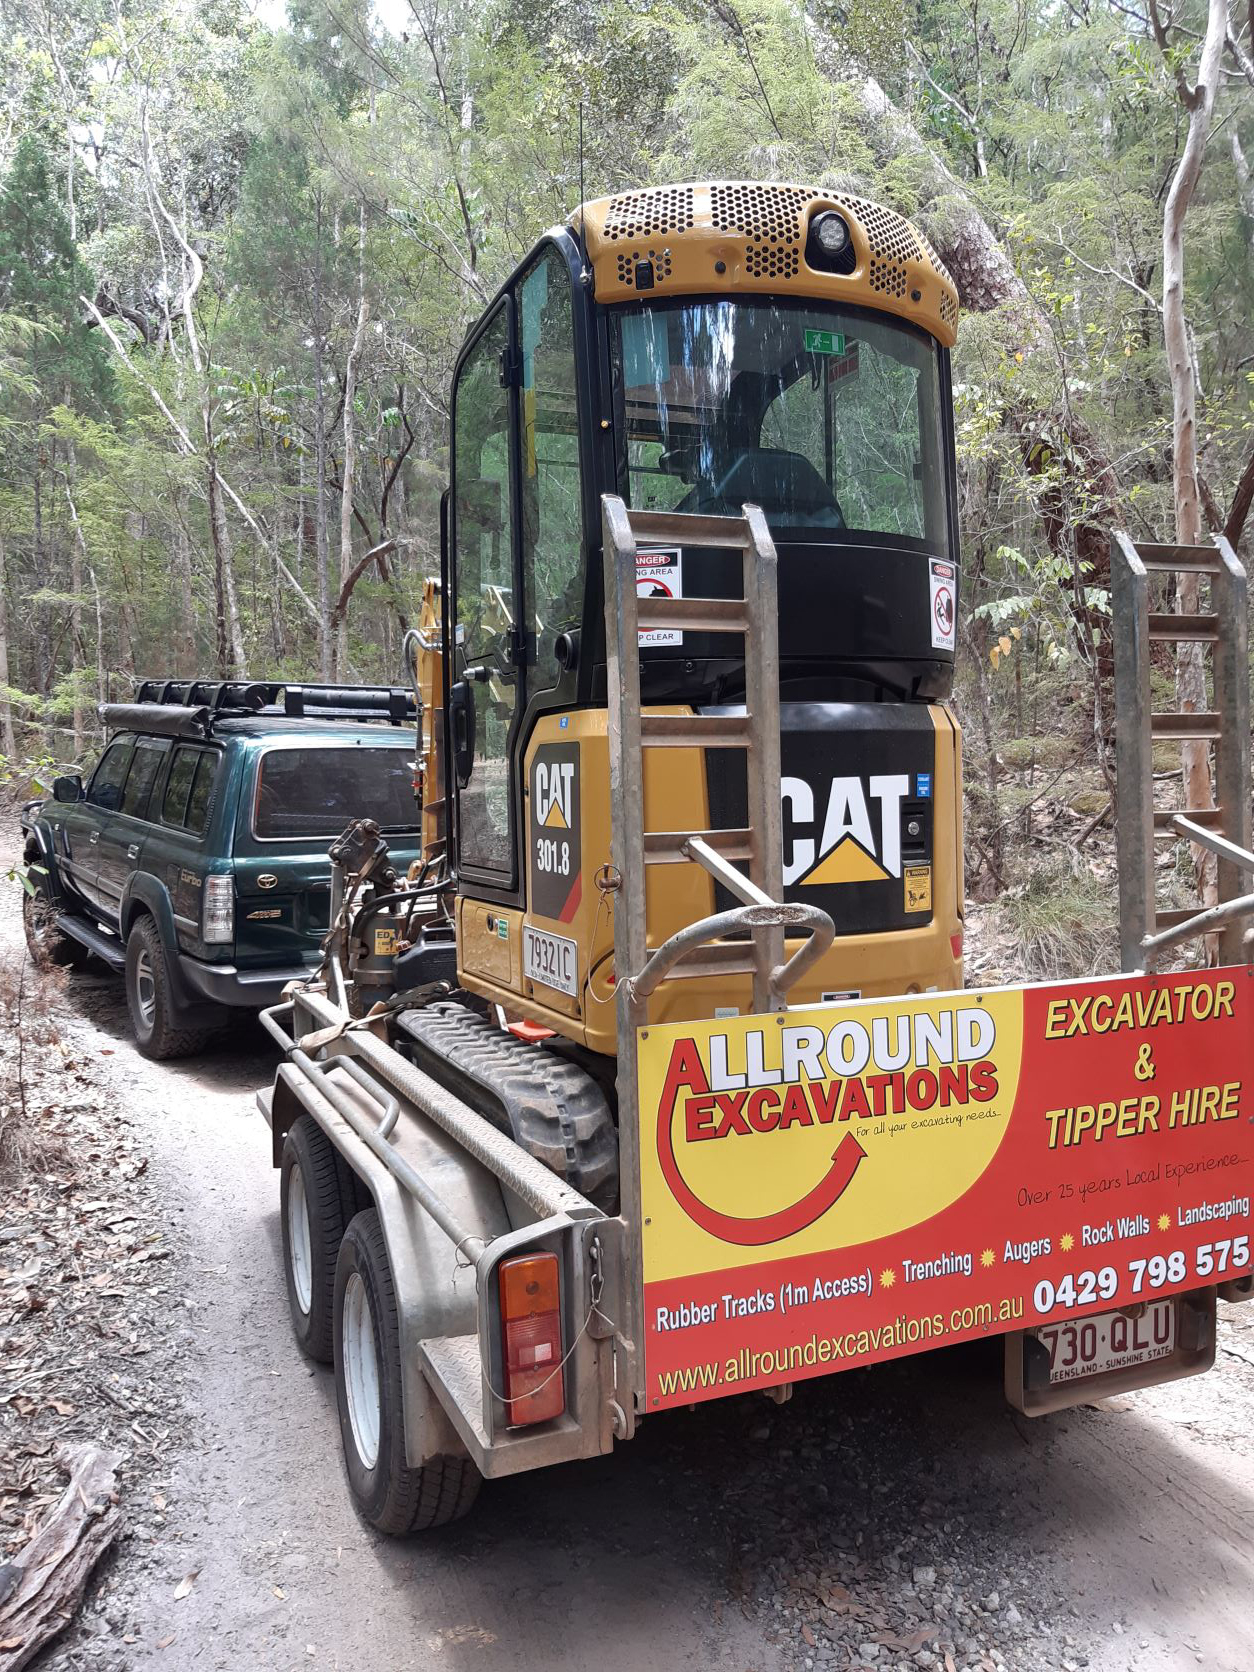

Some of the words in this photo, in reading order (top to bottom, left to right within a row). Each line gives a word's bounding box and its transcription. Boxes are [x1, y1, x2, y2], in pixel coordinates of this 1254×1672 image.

[649, 568, 673, 576] AREA
[646, 633, 674, 641] CLEAR
[535, 762, 575, 829] CAT
[537, 838, 570, 876] 301.8
[781, 774, 909, 886] CAT
[1045, 981, 1236, 1039] EXCAVATOR
[666, 1008, 996, 1095] ALLROUND
[1133, 1042, 1156, 1081] &
[685, 1060, 999, 1143] EXCAVATIONS
[856, 1126, 870, 1137] For
[873, 1121, 886, 1136] all
[887, 1123, 907, 1137] your
[910, 1114, 964, 1130] excavating
[1045, 1095, 1160, 1149] TIPPER
[1169, 1081, 1242, 1128] HIRE
[1017, 1187, 1053, 1207] Over
[1057, 1183, 1075, 1199] 25
[1078, 1177, 1122, 1203] years
[1126, 1163, 1161, 1187] Local
[656, 1300, 718, 1332] Rubber
[721, 1289, 776, 1319] Tracks
[779, 1282, 809, 1314] (1m
[812, 1267, 873, 1302] Access)
[902, 1251, 973, 1283] Trenching
[1003, 1237, 1051, 1264] Augers
[1081, 1220, 1115, 1247] Rock
[1117, 1214, 1151, 1239] Walls
[1177, 1195, 1250, 1227] Landscaping
[1033, 1266, 1118, 1314] 0429
[1128, 1250, 1187, 1294] 798
[1195, 1235, 1250, 1277] 575
[658, 1296, 1024, 1396] www.allroundexcavations.com.au
[1106, 1352, 1144, 1369] SUNSHINE
